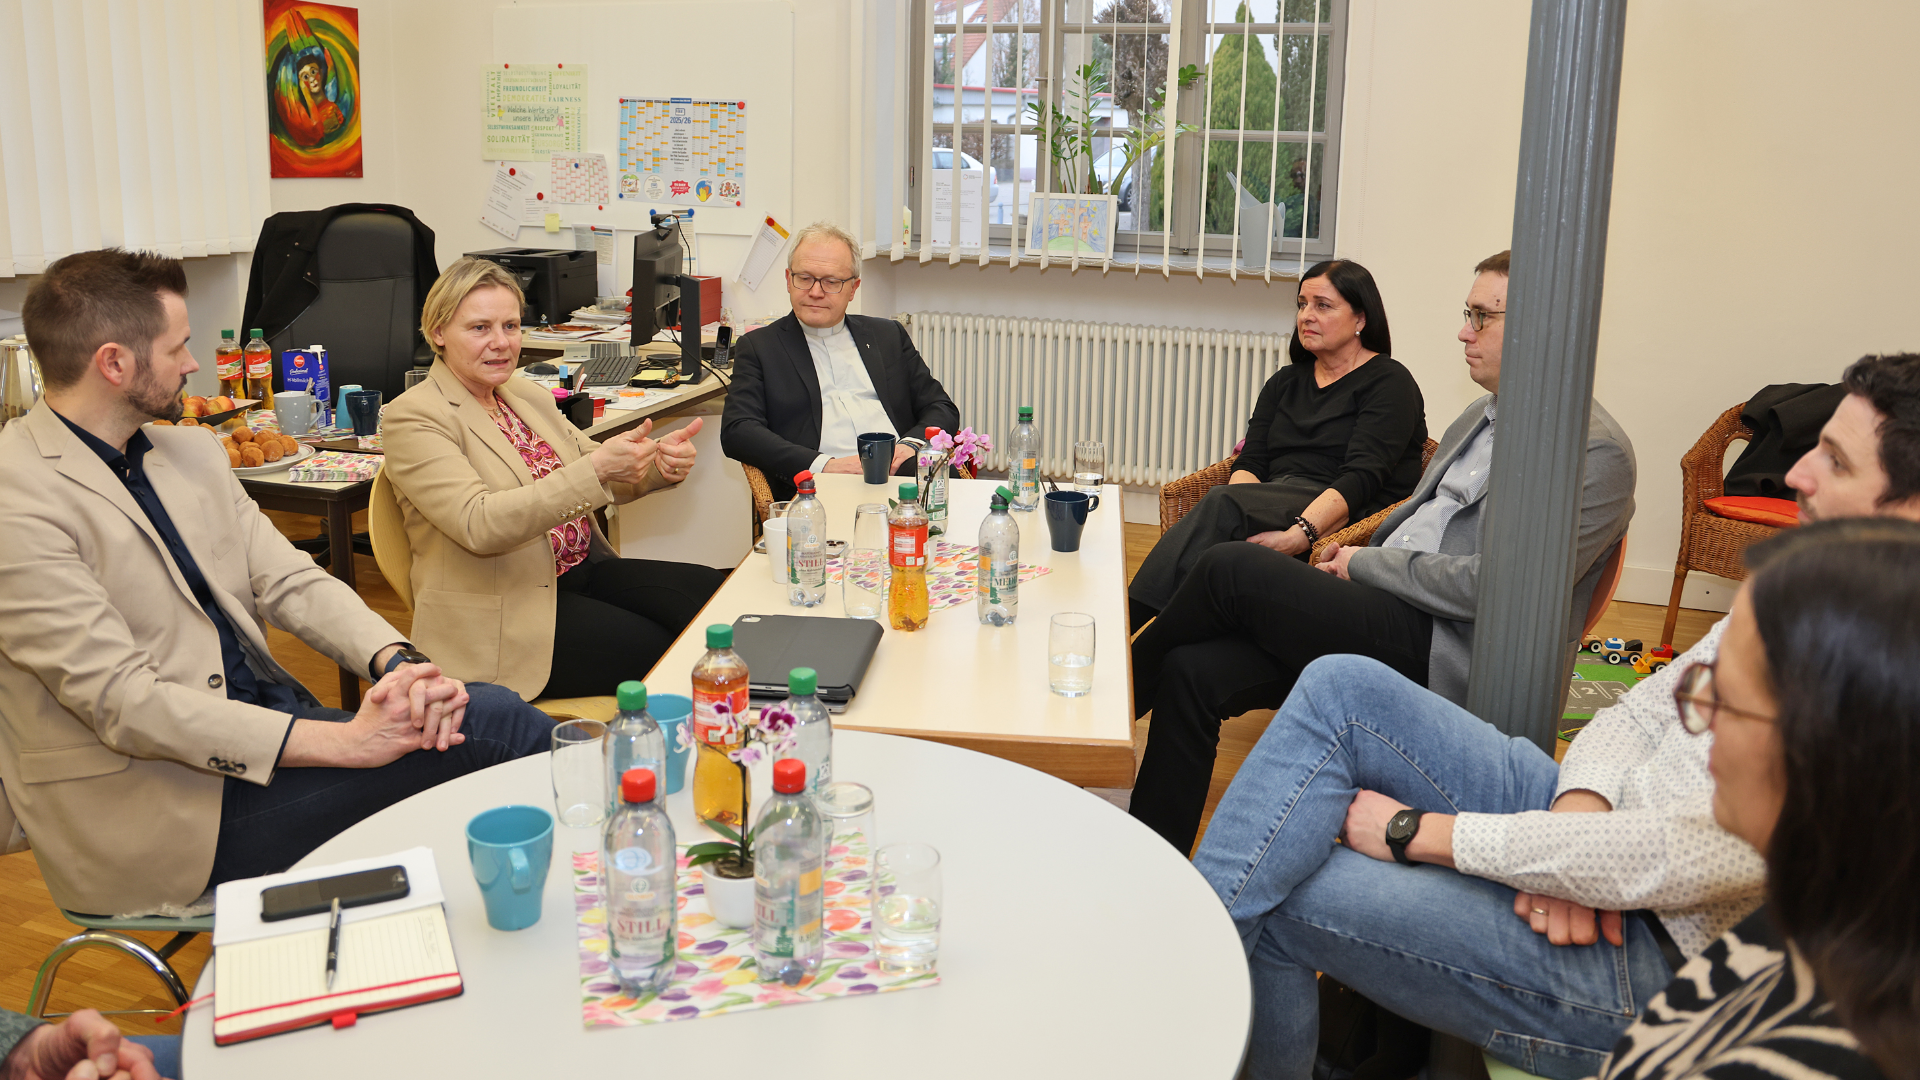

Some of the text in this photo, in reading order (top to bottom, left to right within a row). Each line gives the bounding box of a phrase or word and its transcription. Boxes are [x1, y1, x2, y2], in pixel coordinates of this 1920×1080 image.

[502, 94, 547, 102] DEMOKRATIE
[507, 105, 559, 114] Welche Werte sind
[533, 114, 555, 122] Werte?
[669, 116, 692, 124] 2025/26
[487, 134, 530, 143] SOLIDARITÄT
[798, 558, 823, 568] STILL
[1580, 687, 1598, 695] 2
[617, 918, 666, 934] STILL
